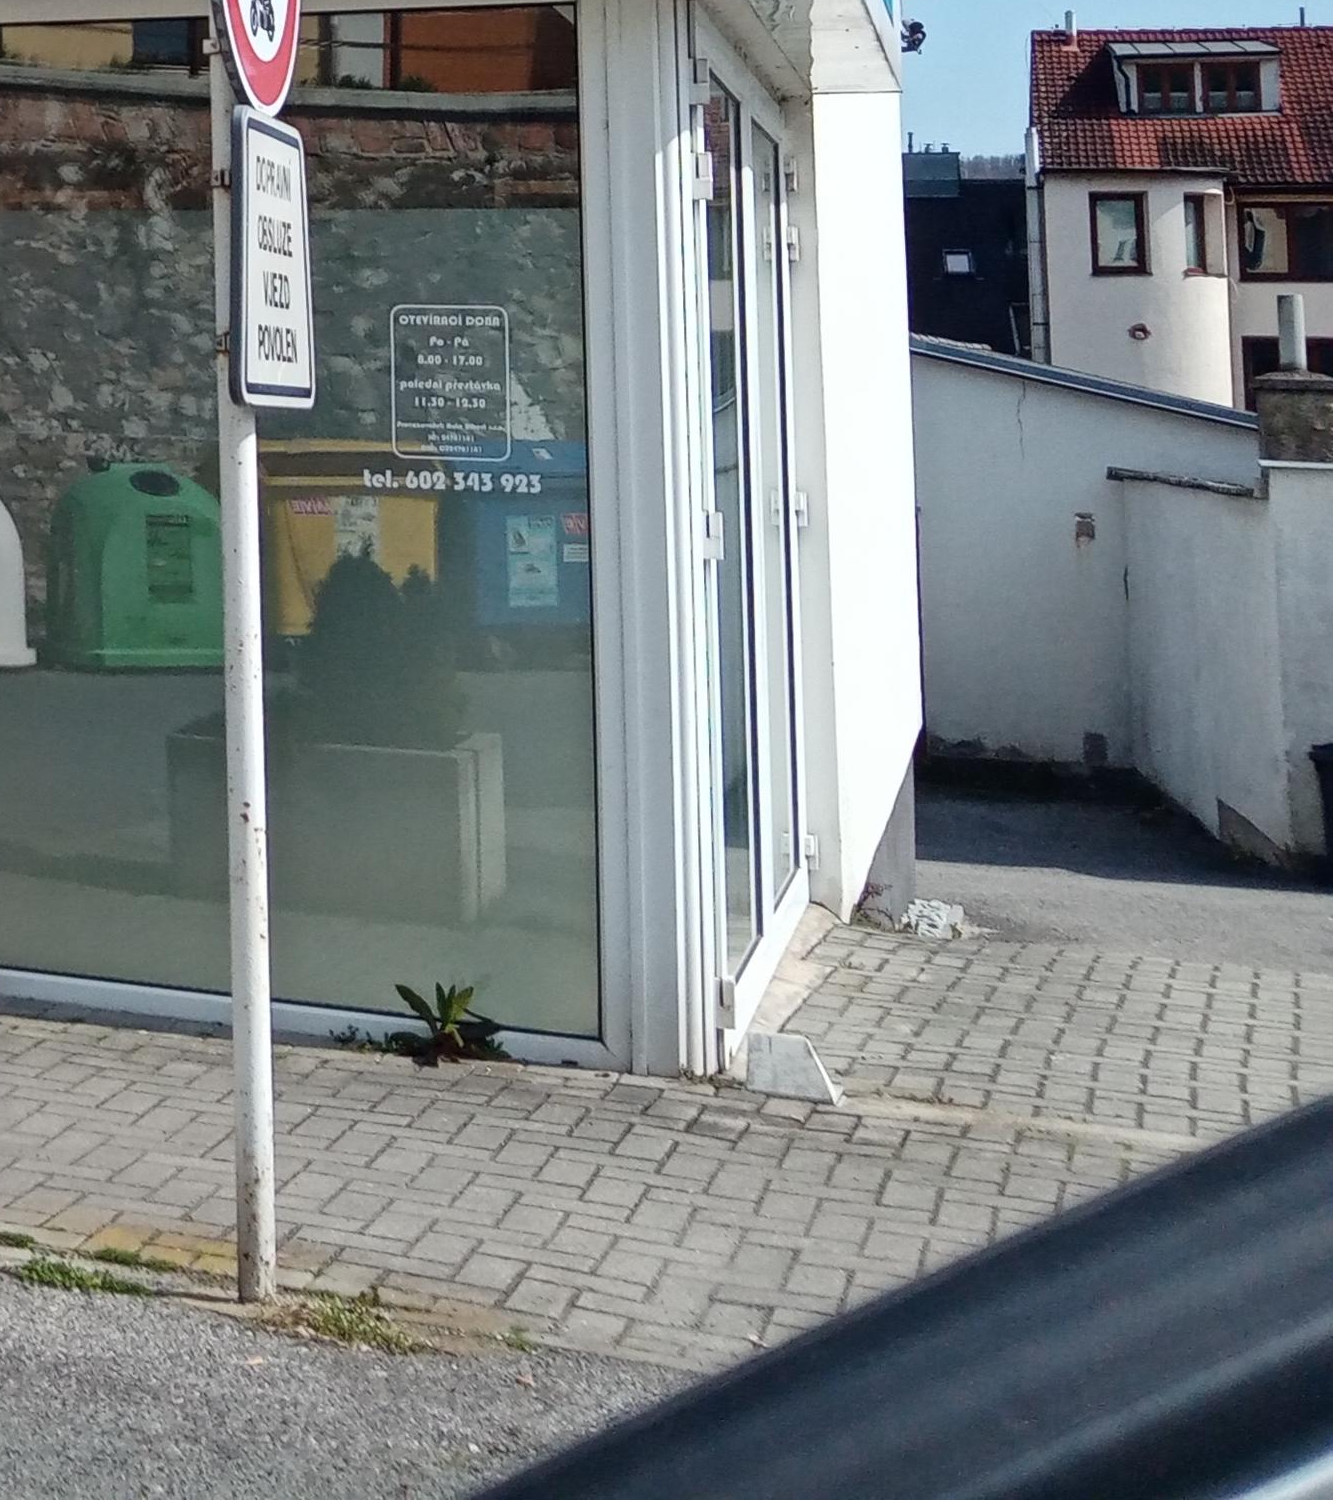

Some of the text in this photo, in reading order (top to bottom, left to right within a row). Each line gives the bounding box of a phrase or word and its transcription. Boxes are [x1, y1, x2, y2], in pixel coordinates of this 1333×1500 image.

[256, 156, 292, 202] DOPRAVNÍ
[258, 214, 293, 258] OBSLUZE
[263, 270, 291, 309] VJEZD
[258, 324, 298, 364] POVOLEN
[429, 336, 445, 347] Po
[453, 355, 483, 366] 17.00
[445, 379, 501, 392] přestávka
[414, 397, 444, 408] 11.30
[456, 397, 486, 409] 12.30
[363, 469, 542, 493] tel. 602 343 923
